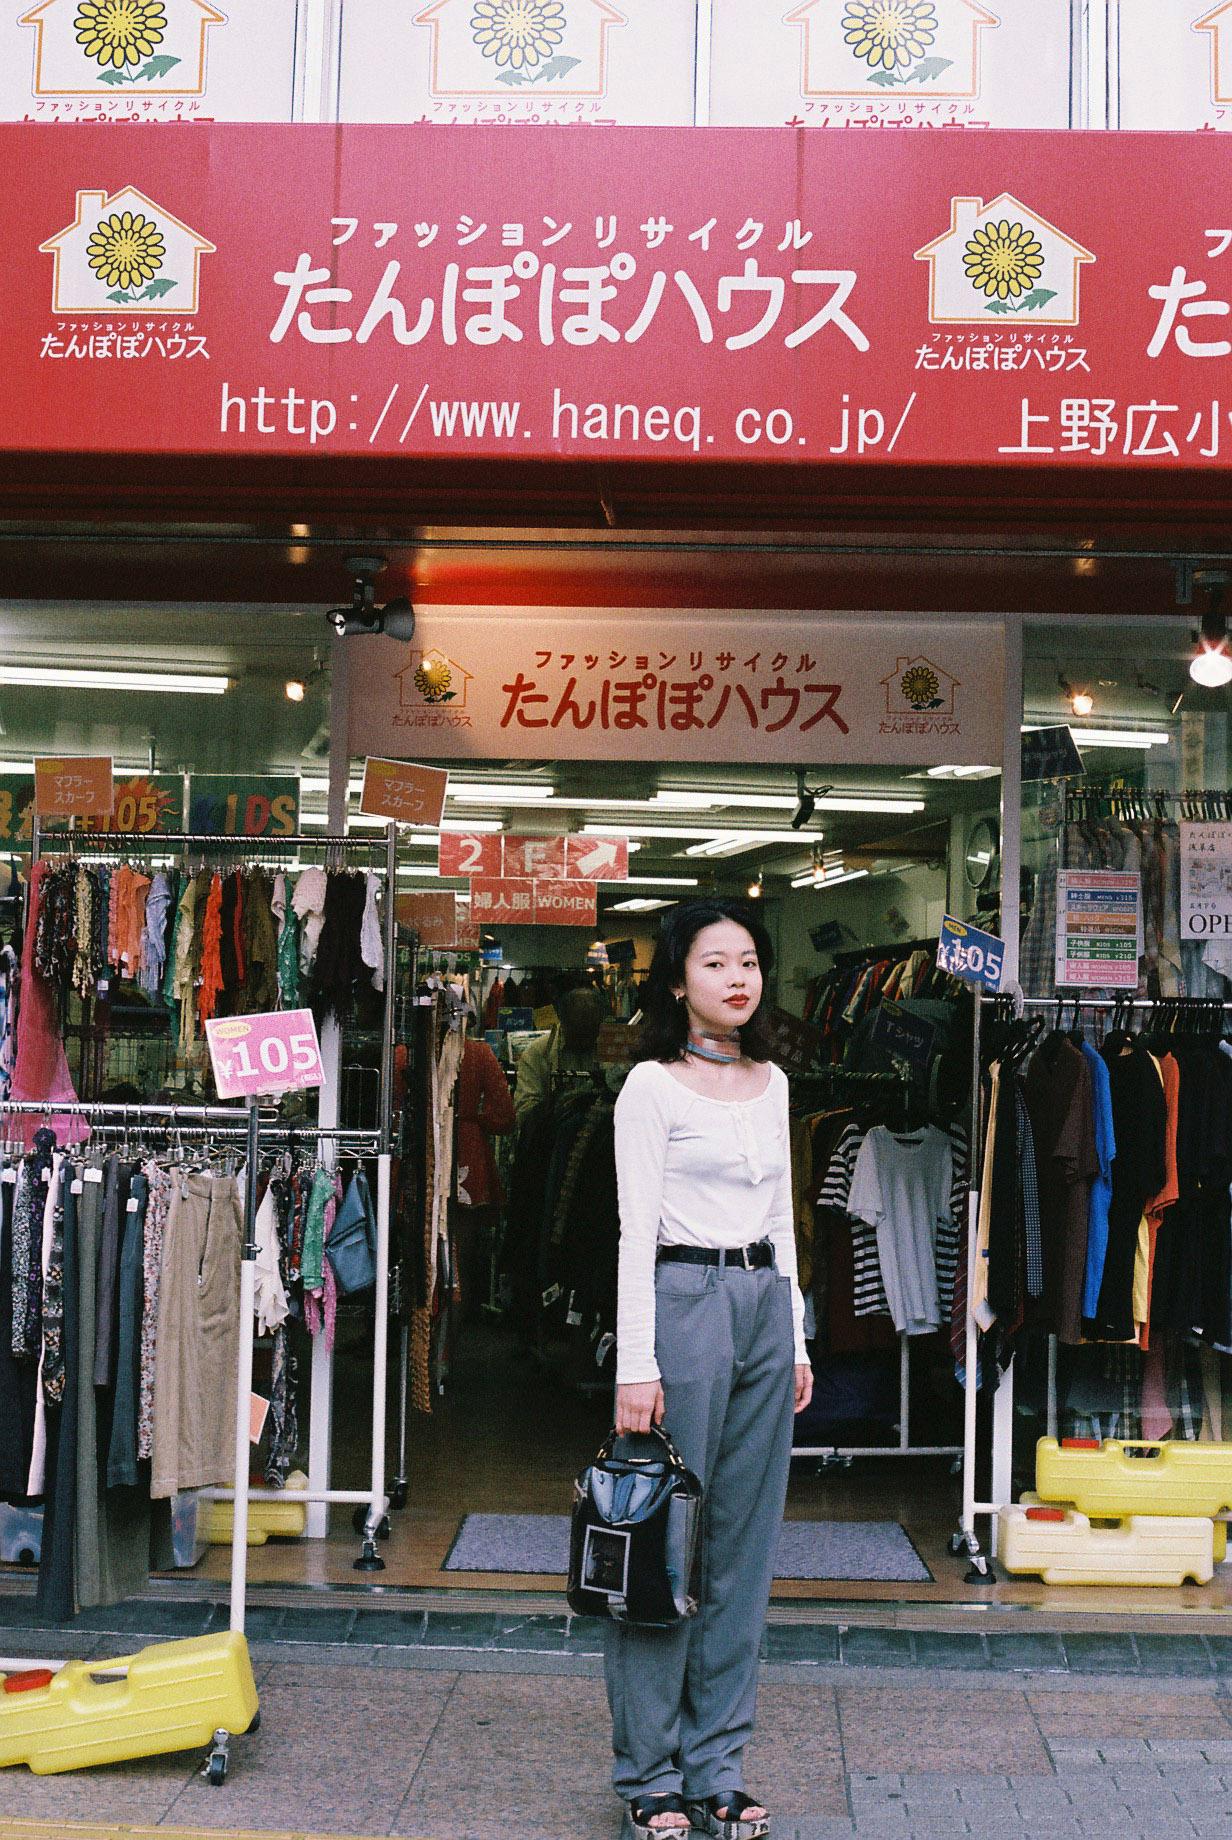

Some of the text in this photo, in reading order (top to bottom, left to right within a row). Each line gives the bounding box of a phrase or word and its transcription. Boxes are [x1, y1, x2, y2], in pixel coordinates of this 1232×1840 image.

[36, 101, 200, 111] ファッションリサイクル
[433, 101, 602, 112] ファッションリサイクル
[804, 102, 975, 114] ファッションリサイクル
[331, 215, 814, 251] ファッションリサイクル
[270, 250, 870, 353] たんぽぽハウス
[1146, 265, 1232, 358] た
[56, 322, 195, 333] ファッションリサイクル
[931, 332, 1074, 345] ファッションリサイクル
[40, 332, 210, 360] たんぽぽハウス
[914, 343, 1091, 373] たんぽぽハウス
[997, 397, 1232, 457] 上野広小
[536, 650, 816, 673] ファッションリサイクル
[500, 672, 850, 735] たんぽぽハウス
[474, 891, 595, 911] 婦人服 WOMEN
